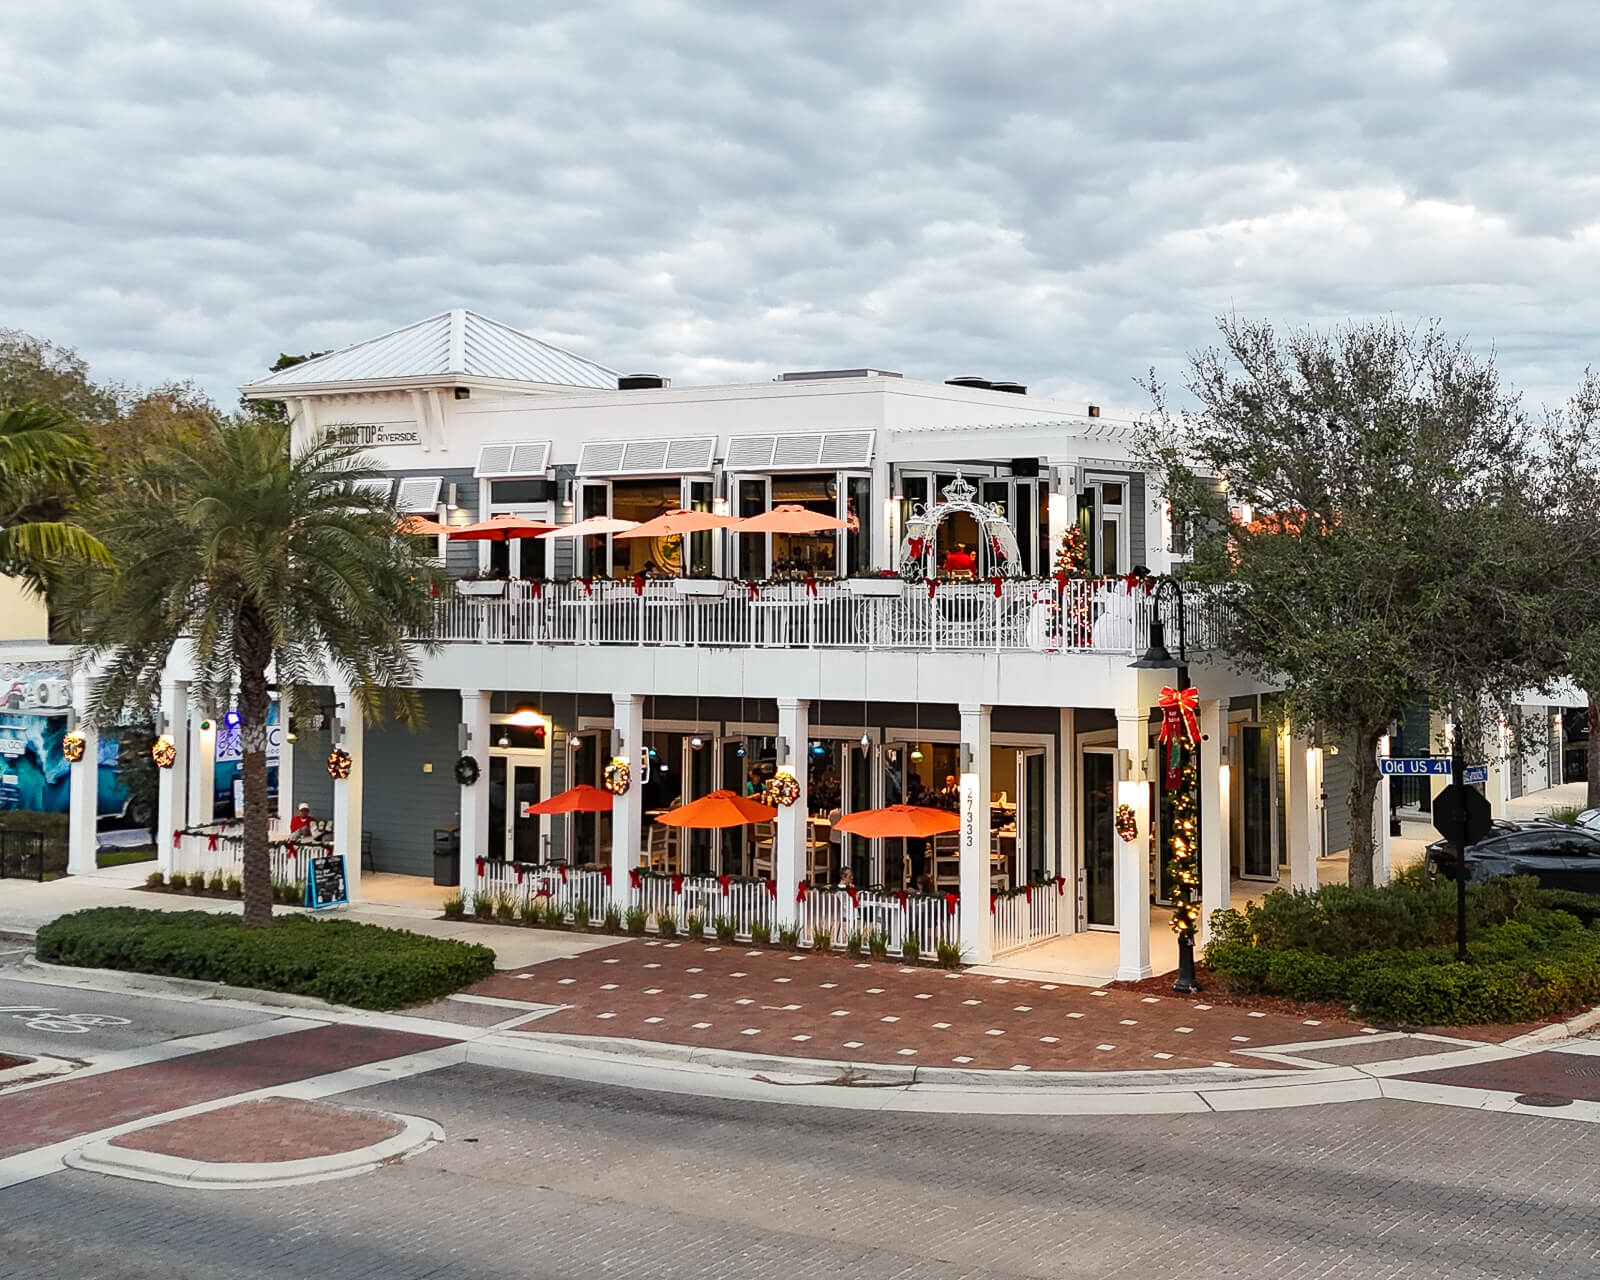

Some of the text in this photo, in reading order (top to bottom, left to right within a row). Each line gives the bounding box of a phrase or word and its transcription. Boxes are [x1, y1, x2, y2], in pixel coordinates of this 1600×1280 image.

[377, 432, 417, 442] RIVERSIDE
[1385, 761, 1447, 773] Old US 41
